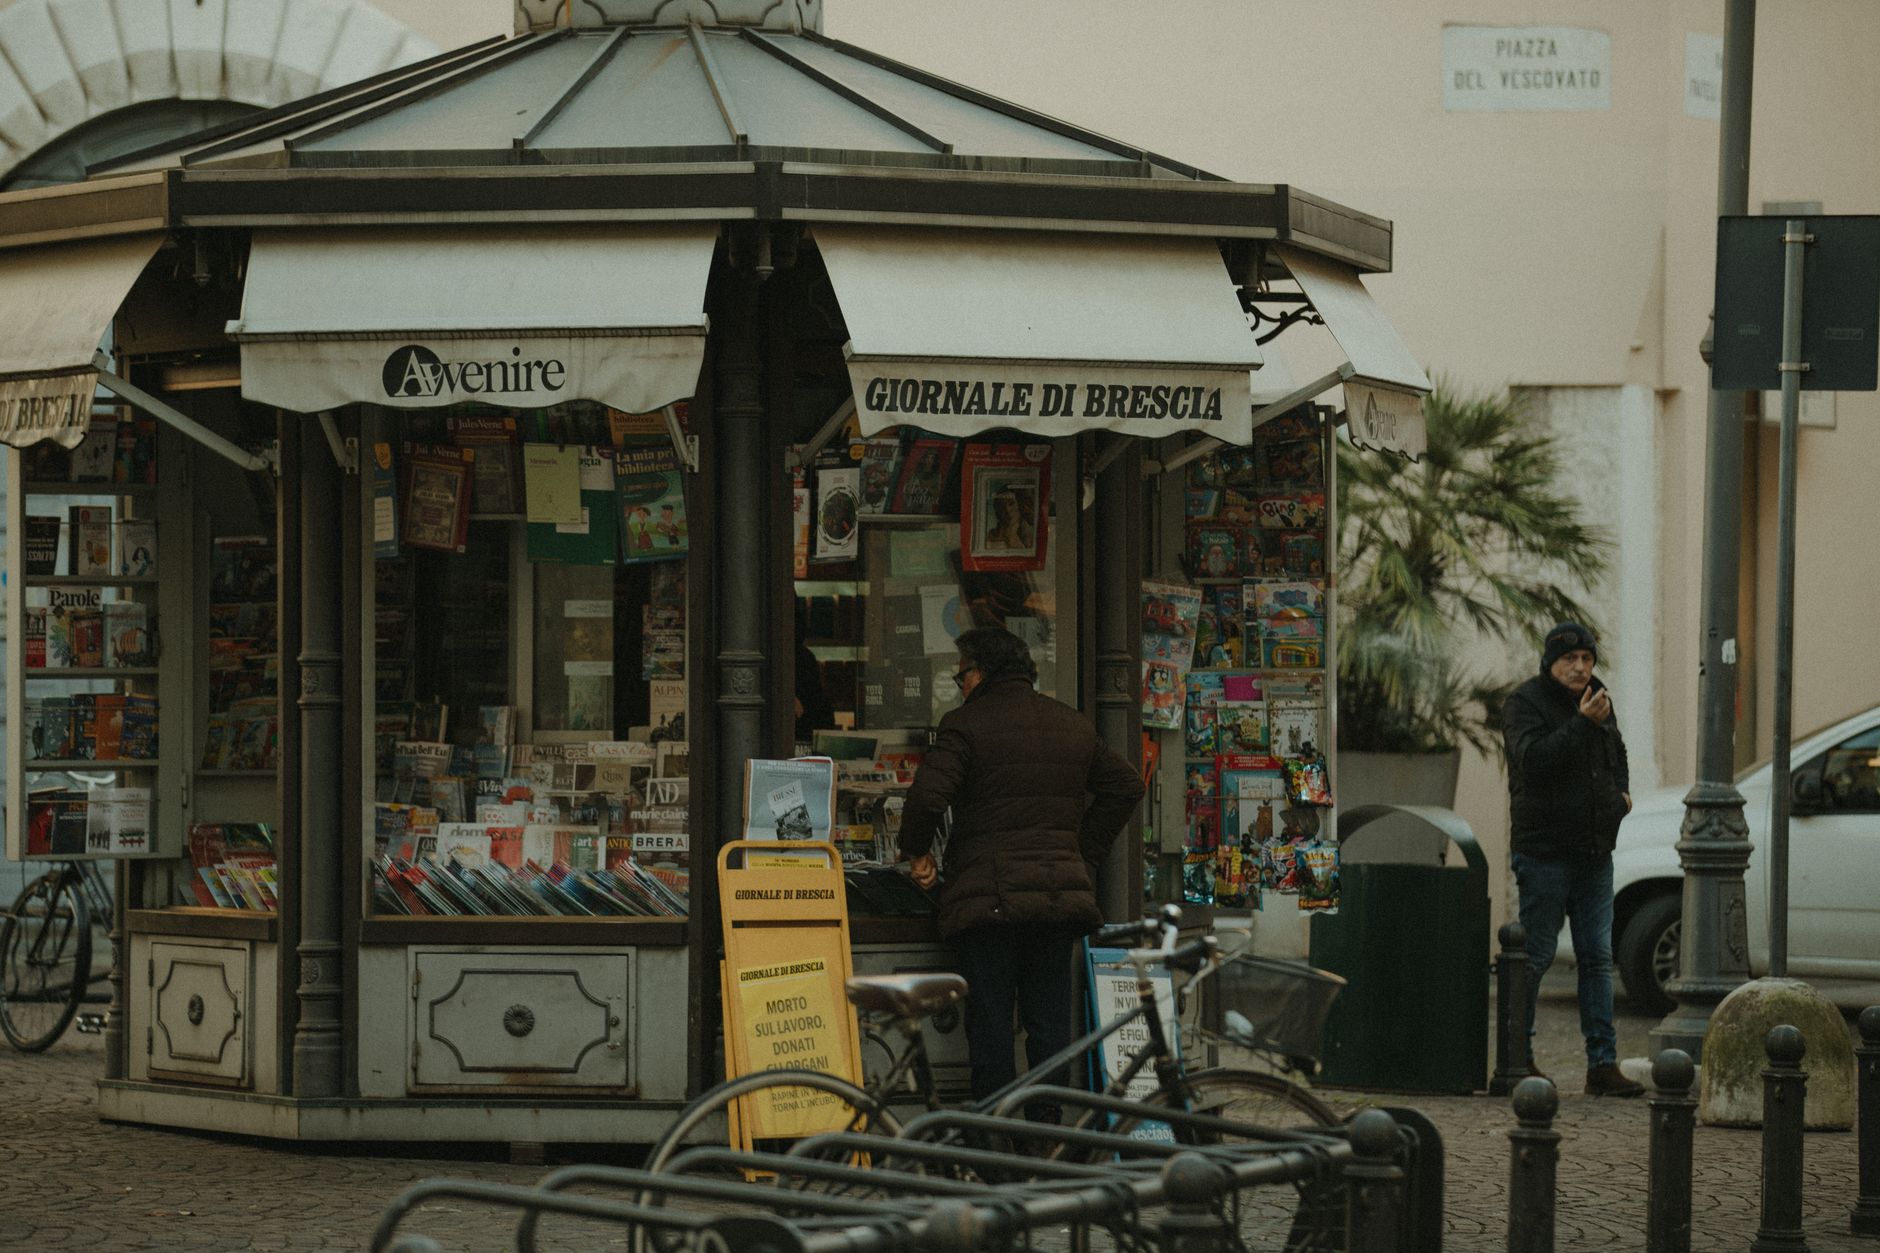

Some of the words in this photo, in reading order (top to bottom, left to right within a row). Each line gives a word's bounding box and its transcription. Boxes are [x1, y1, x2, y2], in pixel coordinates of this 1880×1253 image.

[1496, 38, 1558, 58] PIAZZA
[1453, 71, 1487, 90] DEL
[1500, 69, 1600, 90] VESCOVATO
[865, 376, 1034, 417] GIORNALE
[1039, 383, 1078, 417] DI
[1083, 385, 1223, 421] BRESCIA
[49, 588, 100, 608] Parole
[651, 782, 680, 805] AD
[636, 837, 685, 847] BRERA
[841, 851, 866, 860] orbes
[735, 889, 782, 900] GIORNALE
[783, 889, 793, 900] DI
[795, 889, 835, 900] BRESCIA
[740, 967, 780, 982] GIORNALE
[780, 965, 789, 976] DI
[789, 961, 825, 975] BRESCIA
[766, 996, 808, 1015] MORTO
[755, 1020, 776, 1038] SUL
[777, 1015, 826, 1034] LAVORO,
[1120, 1029, 1126, 1040] E
[772, 1037, 816, 1056] DONATI
[785, 1055, 830, 1072] ORGANI
[772, 1101, 800, 1113] TORNA
